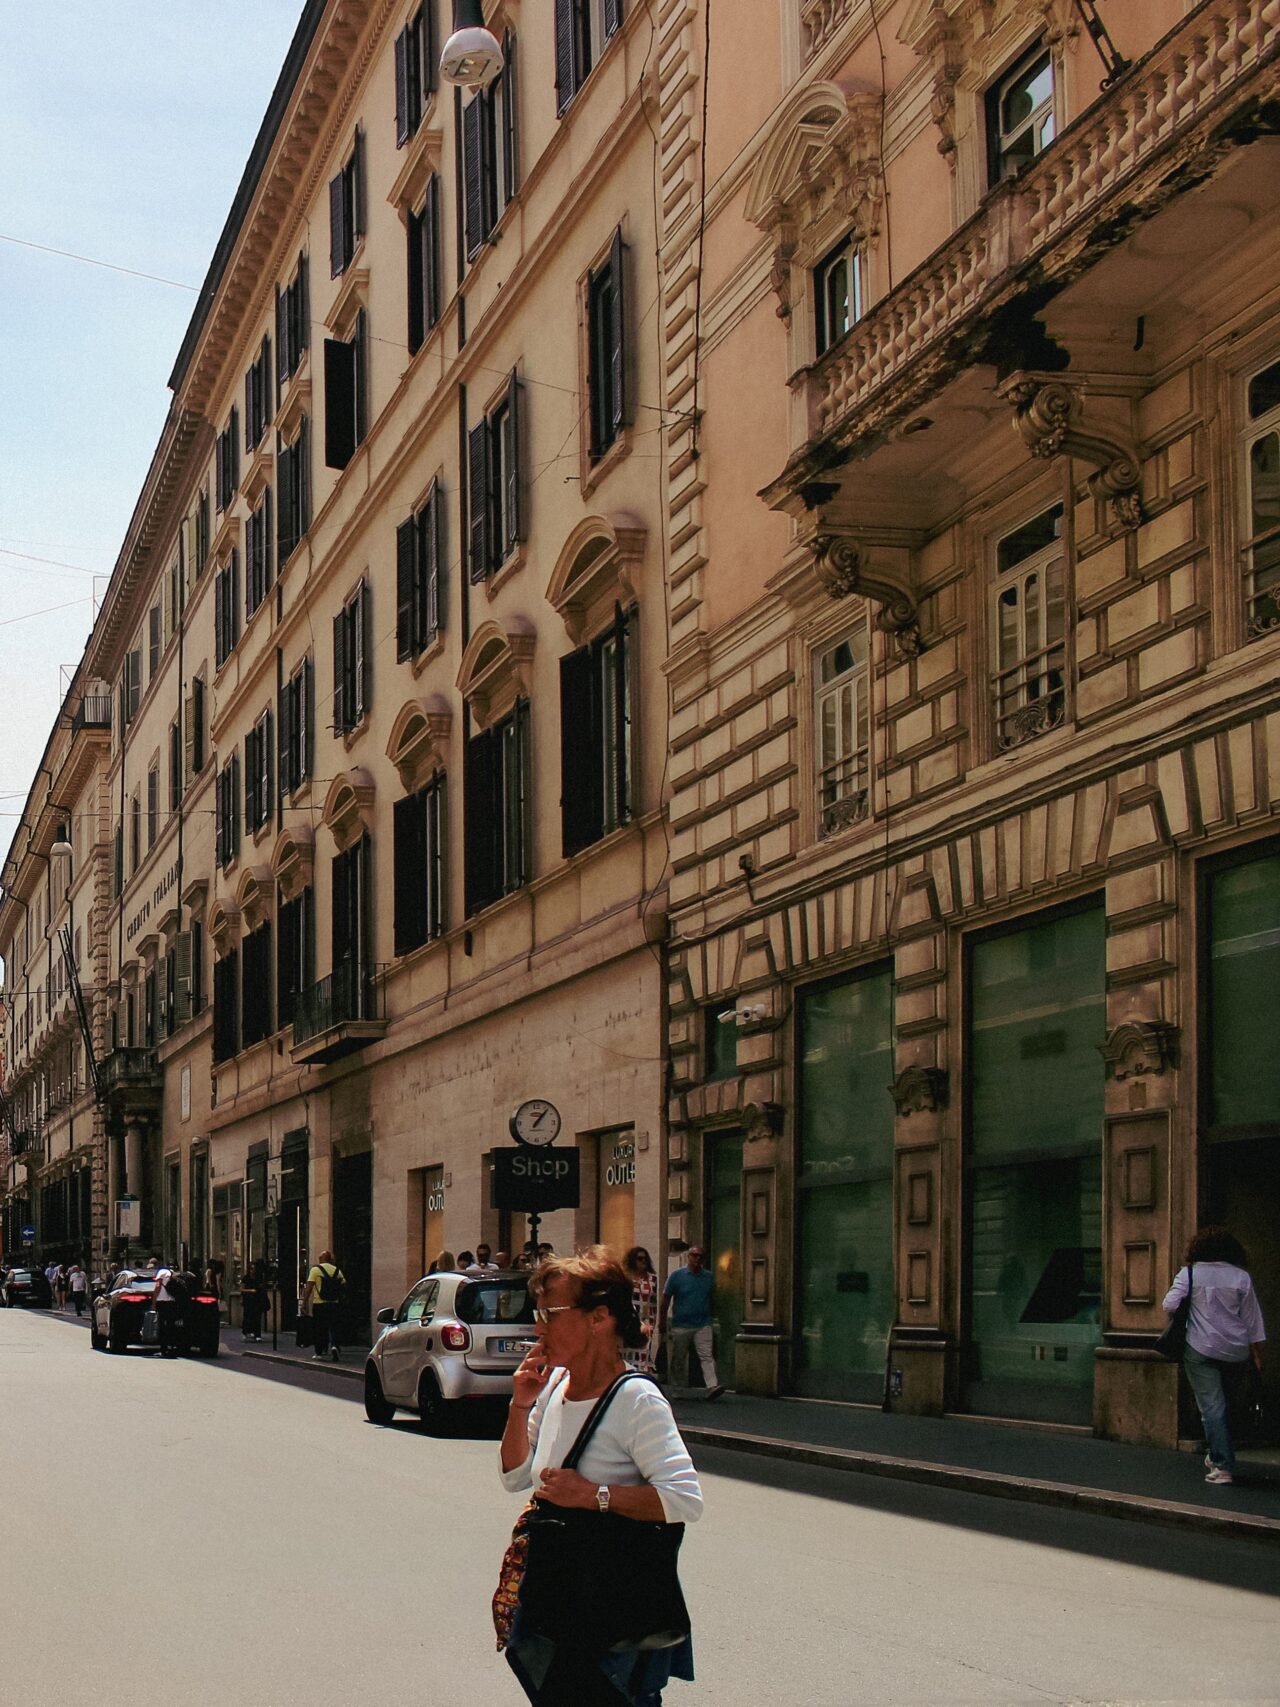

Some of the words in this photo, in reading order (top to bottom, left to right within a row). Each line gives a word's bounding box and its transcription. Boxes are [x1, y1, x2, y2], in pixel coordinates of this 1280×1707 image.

[126, 900, 151, 942] CREDITO
[153, 860, 180, 909] ITALIAN
[612, 1144, 635, 1160] LUXUR
[511, 1155, 569, 1180] Shop
[606, 1162, 636, 1186] OUTLE
[428, 1194, 444, 1211] OUTL
[505, 1341, 516, 1351] EZ
